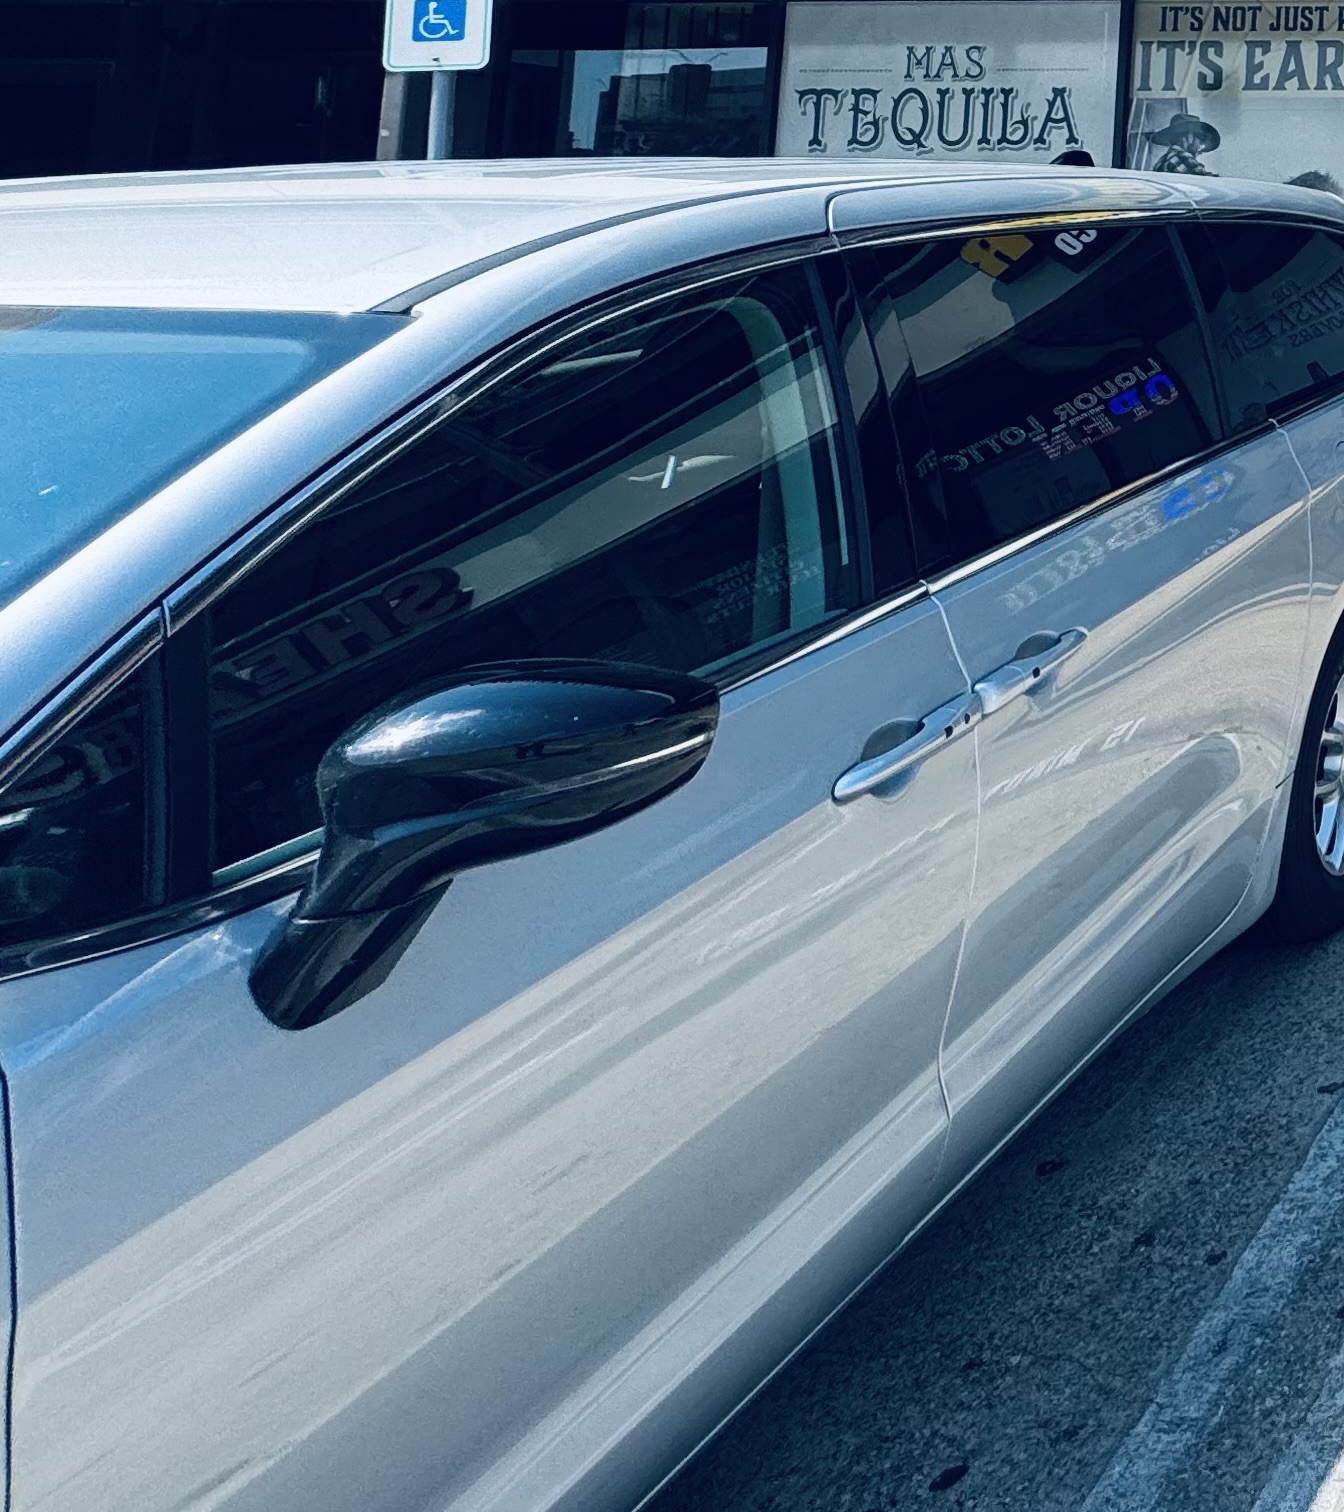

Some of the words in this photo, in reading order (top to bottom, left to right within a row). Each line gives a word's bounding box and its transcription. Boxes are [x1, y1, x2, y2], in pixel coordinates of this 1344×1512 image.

[1159, 5, 1203, 33] IT'S
[1211, 6, 1262, 33] NOT
[1269, 6, 1331, 33] JUST
[904, 45, 987, 81] MAS
[1137, 40, 1226, 92] IT'S
[795, 86, 1085, 156] TEQUILA
